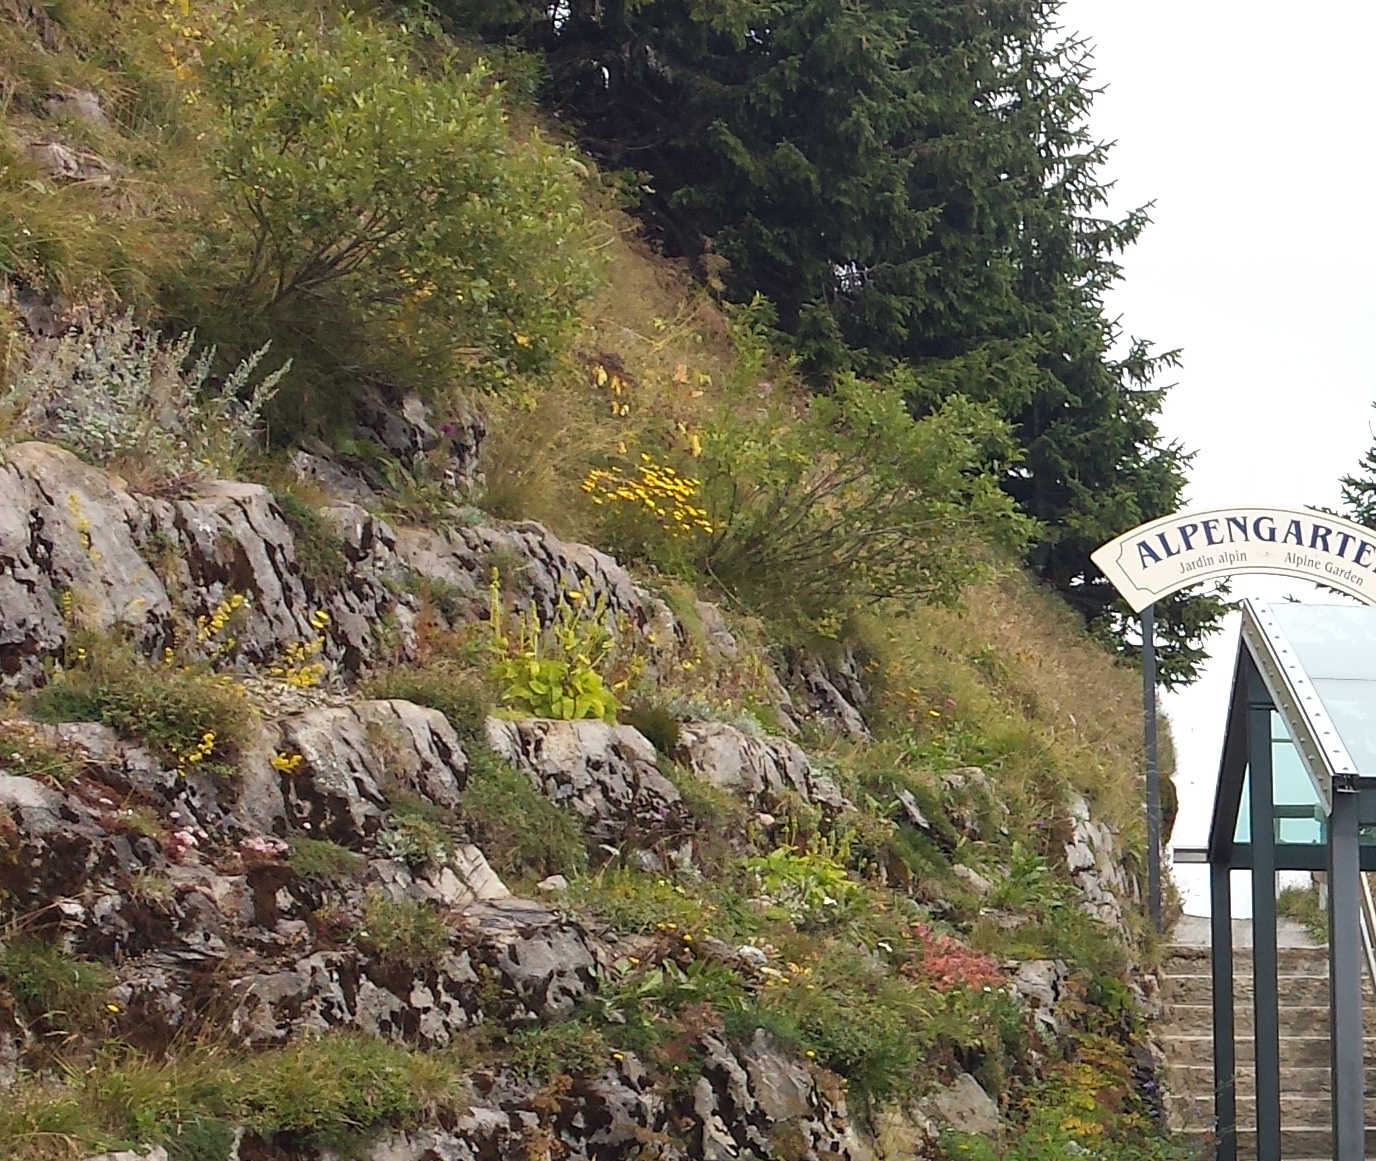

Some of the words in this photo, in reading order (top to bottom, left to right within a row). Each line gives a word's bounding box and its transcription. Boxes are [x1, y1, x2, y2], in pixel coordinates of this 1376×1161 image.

[1179, 556, 1214, 574] Jardin
[1218, 550, 1248, 566] alpin
[1284, 551, 1322, 571] Alpine
[1324, 561, 1364, 587] Garden
